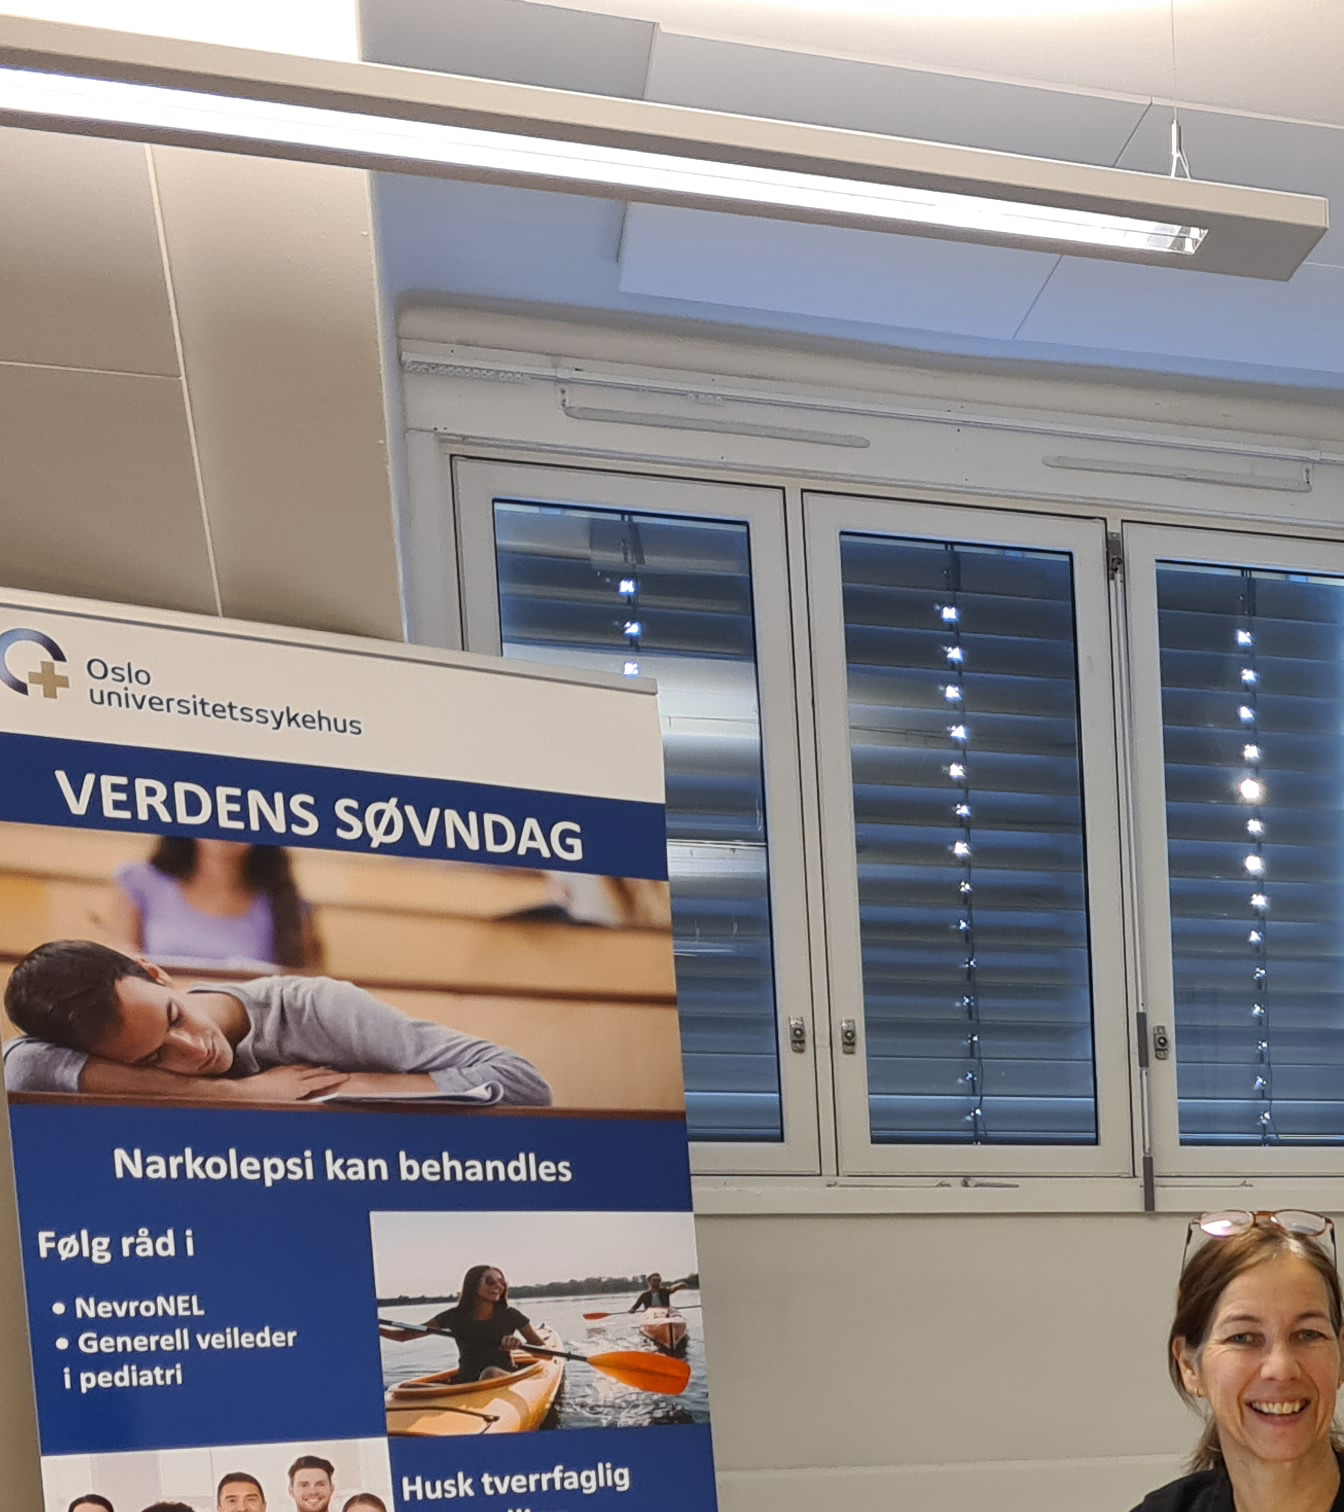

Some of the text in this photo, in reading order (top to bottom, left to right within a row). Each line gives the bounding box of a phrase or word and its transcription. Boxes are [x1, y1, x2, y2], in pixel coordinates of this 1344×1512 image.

[86, 658, 152, 686] Oslo
[89, 685, 362, 736] universitetssykehus
[53, 769, 584, 862] VERDENS SØVNDAG
[113, 1146, 572, 1188] Narkolepsi kan behandles
[38, 1227, 194, 1264] Følg råd i
[75, 1294, 205, 1319] NevroNEL
[78, 1325, 298, 1354] Generell veileder
[63, 1362, 183, 1394] i pediatri
[402, 1462, 630, 1502] Husk tverrfaglig
